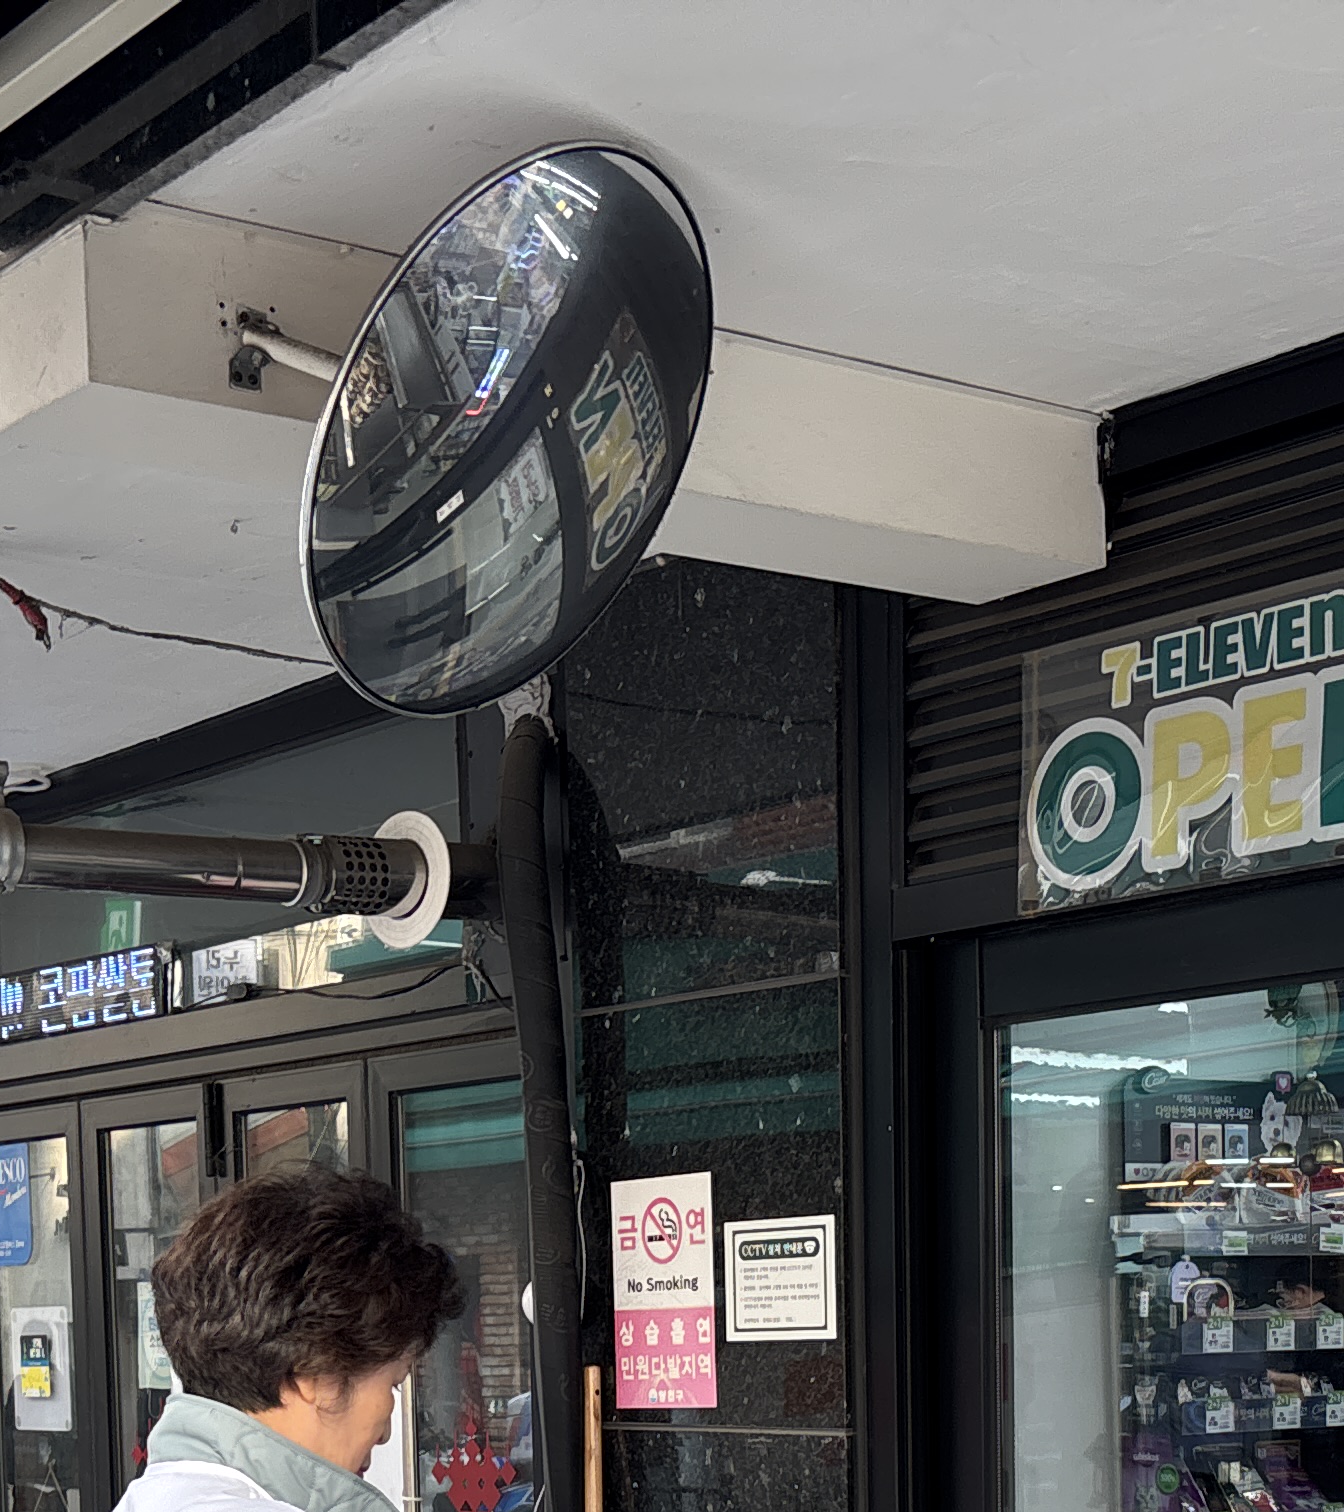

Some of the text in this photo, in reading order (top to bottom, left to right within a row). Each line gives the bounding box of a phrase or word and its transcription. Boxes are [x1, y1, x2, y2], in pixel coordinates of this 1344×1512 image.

[617, 1214, 639, 1251] 금
[685, 1206, 706, 1246] 연
[741, 1242, 766, 1258] CCTV
[627, 1274, 699, 1293] No Smoking
[620, 1353, 712, 1380] 민원다발지역
